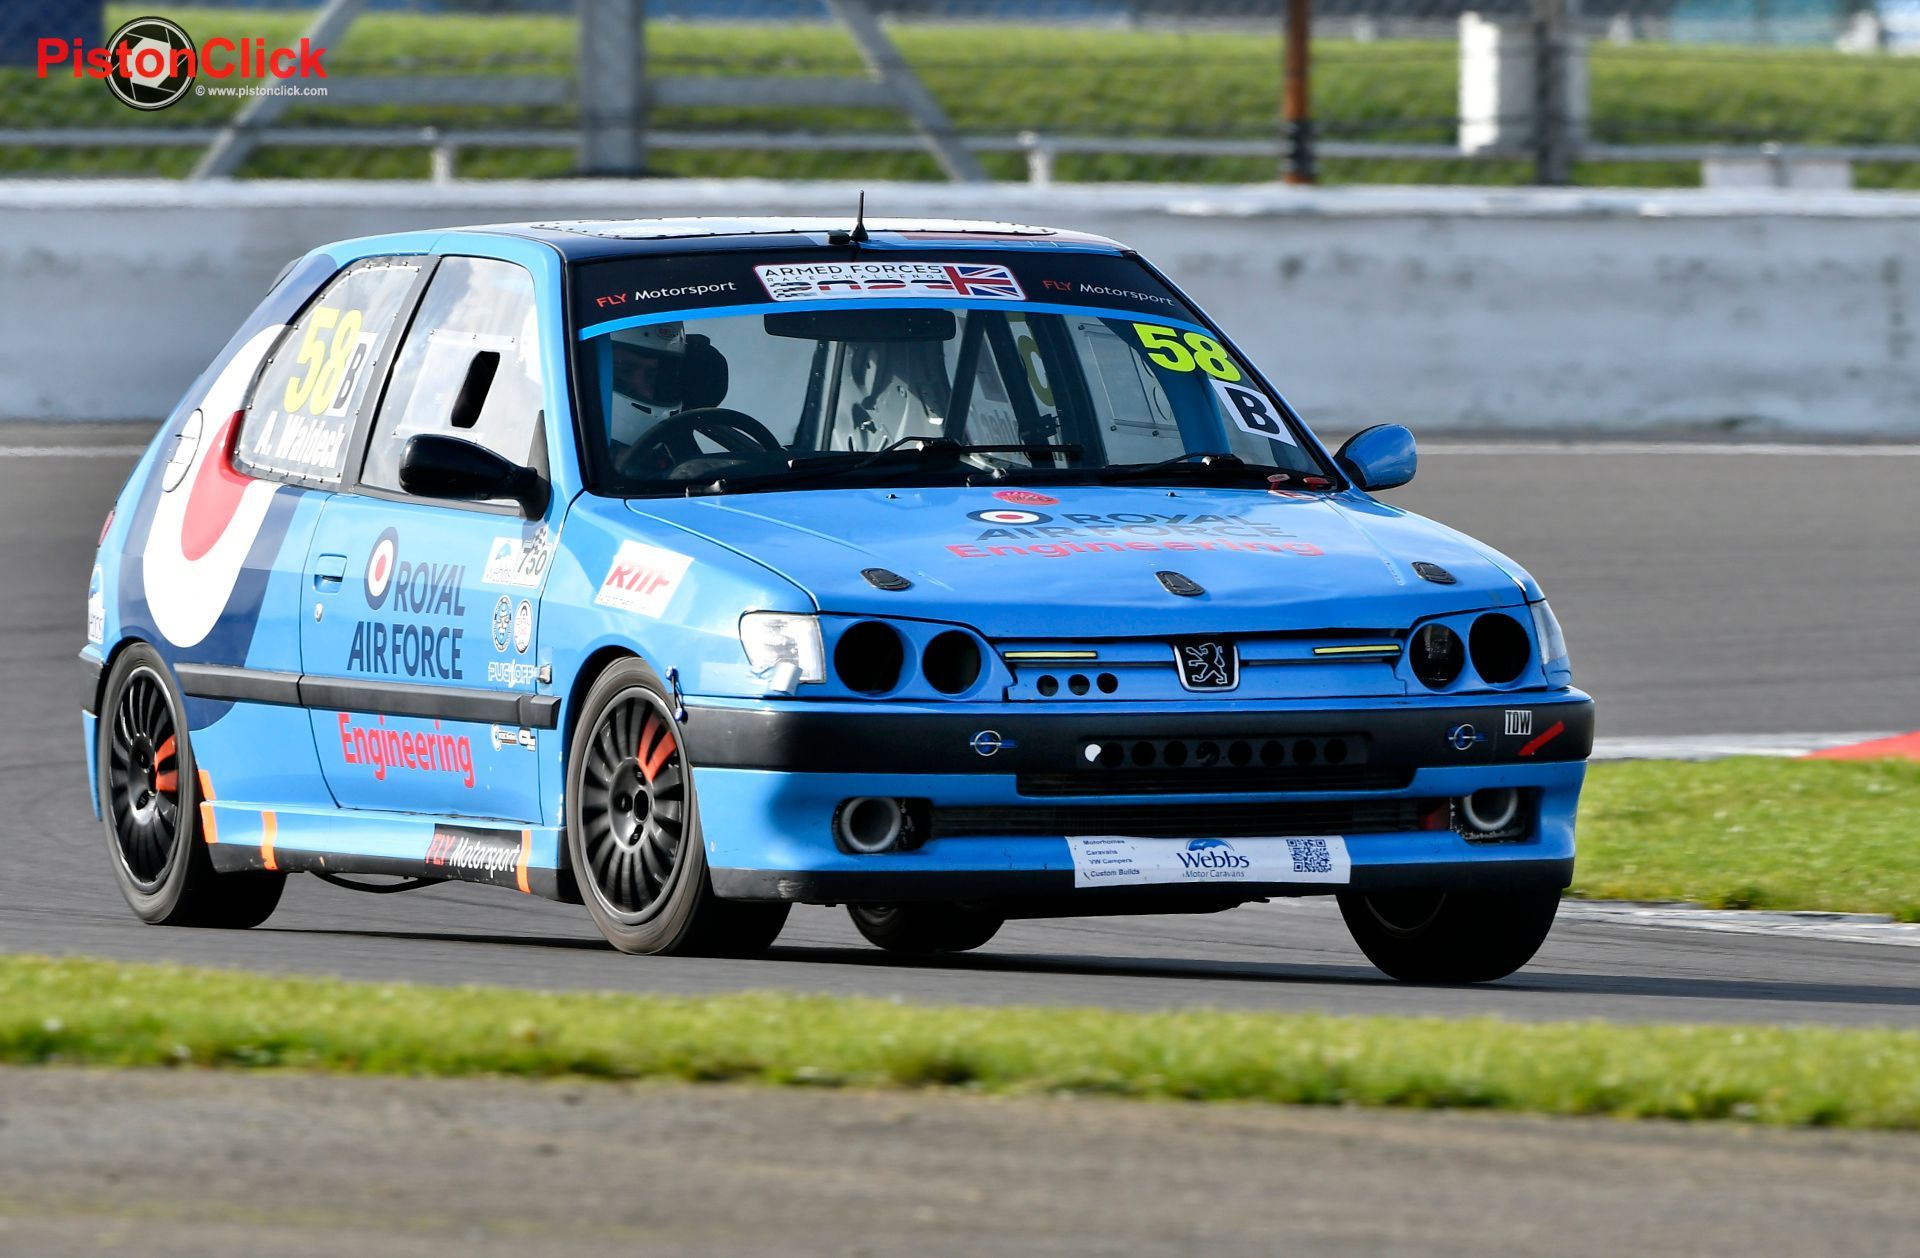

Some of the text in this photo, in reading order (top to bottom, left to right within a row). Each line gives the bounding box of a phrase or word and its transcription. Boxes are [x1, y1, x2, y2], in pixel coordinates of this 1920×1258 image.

[765, 264, 942, 277] ARMED FORCES
[767, 273, 948, 283] RACE CHALLENGE
[596, 281, 737, 308] FLY Motorsport
[1042, 280, 1175, 307] FLY Motorsport
[284, 306, 363, 416] 58
[1132, 322, 1241, 382] 58
[333, 342, 368, 409] B
[1224, 386, 1281, 435] B
[976, 524, 1297, 541] AIR FORCE
[1060, 512, 1275, 526] ROYAL
[944, 538, 1326, 559] Engineering
[393, 560, 466, 617] ROYAL
[346, 620, 389, 674] AIR
[392, 622, 465, 680] FORCE
[1506, 711, 1531, 734] TOW
[337, 712, 476, 788] Engineering
[425, 833, 520, 879] FLY Motorsport
[1176, 850, 1250, 869] Webbs
[1090, 868, 1141, 878] Custom Builds
[1185, 869, 1245, 878] Motor Caravans
